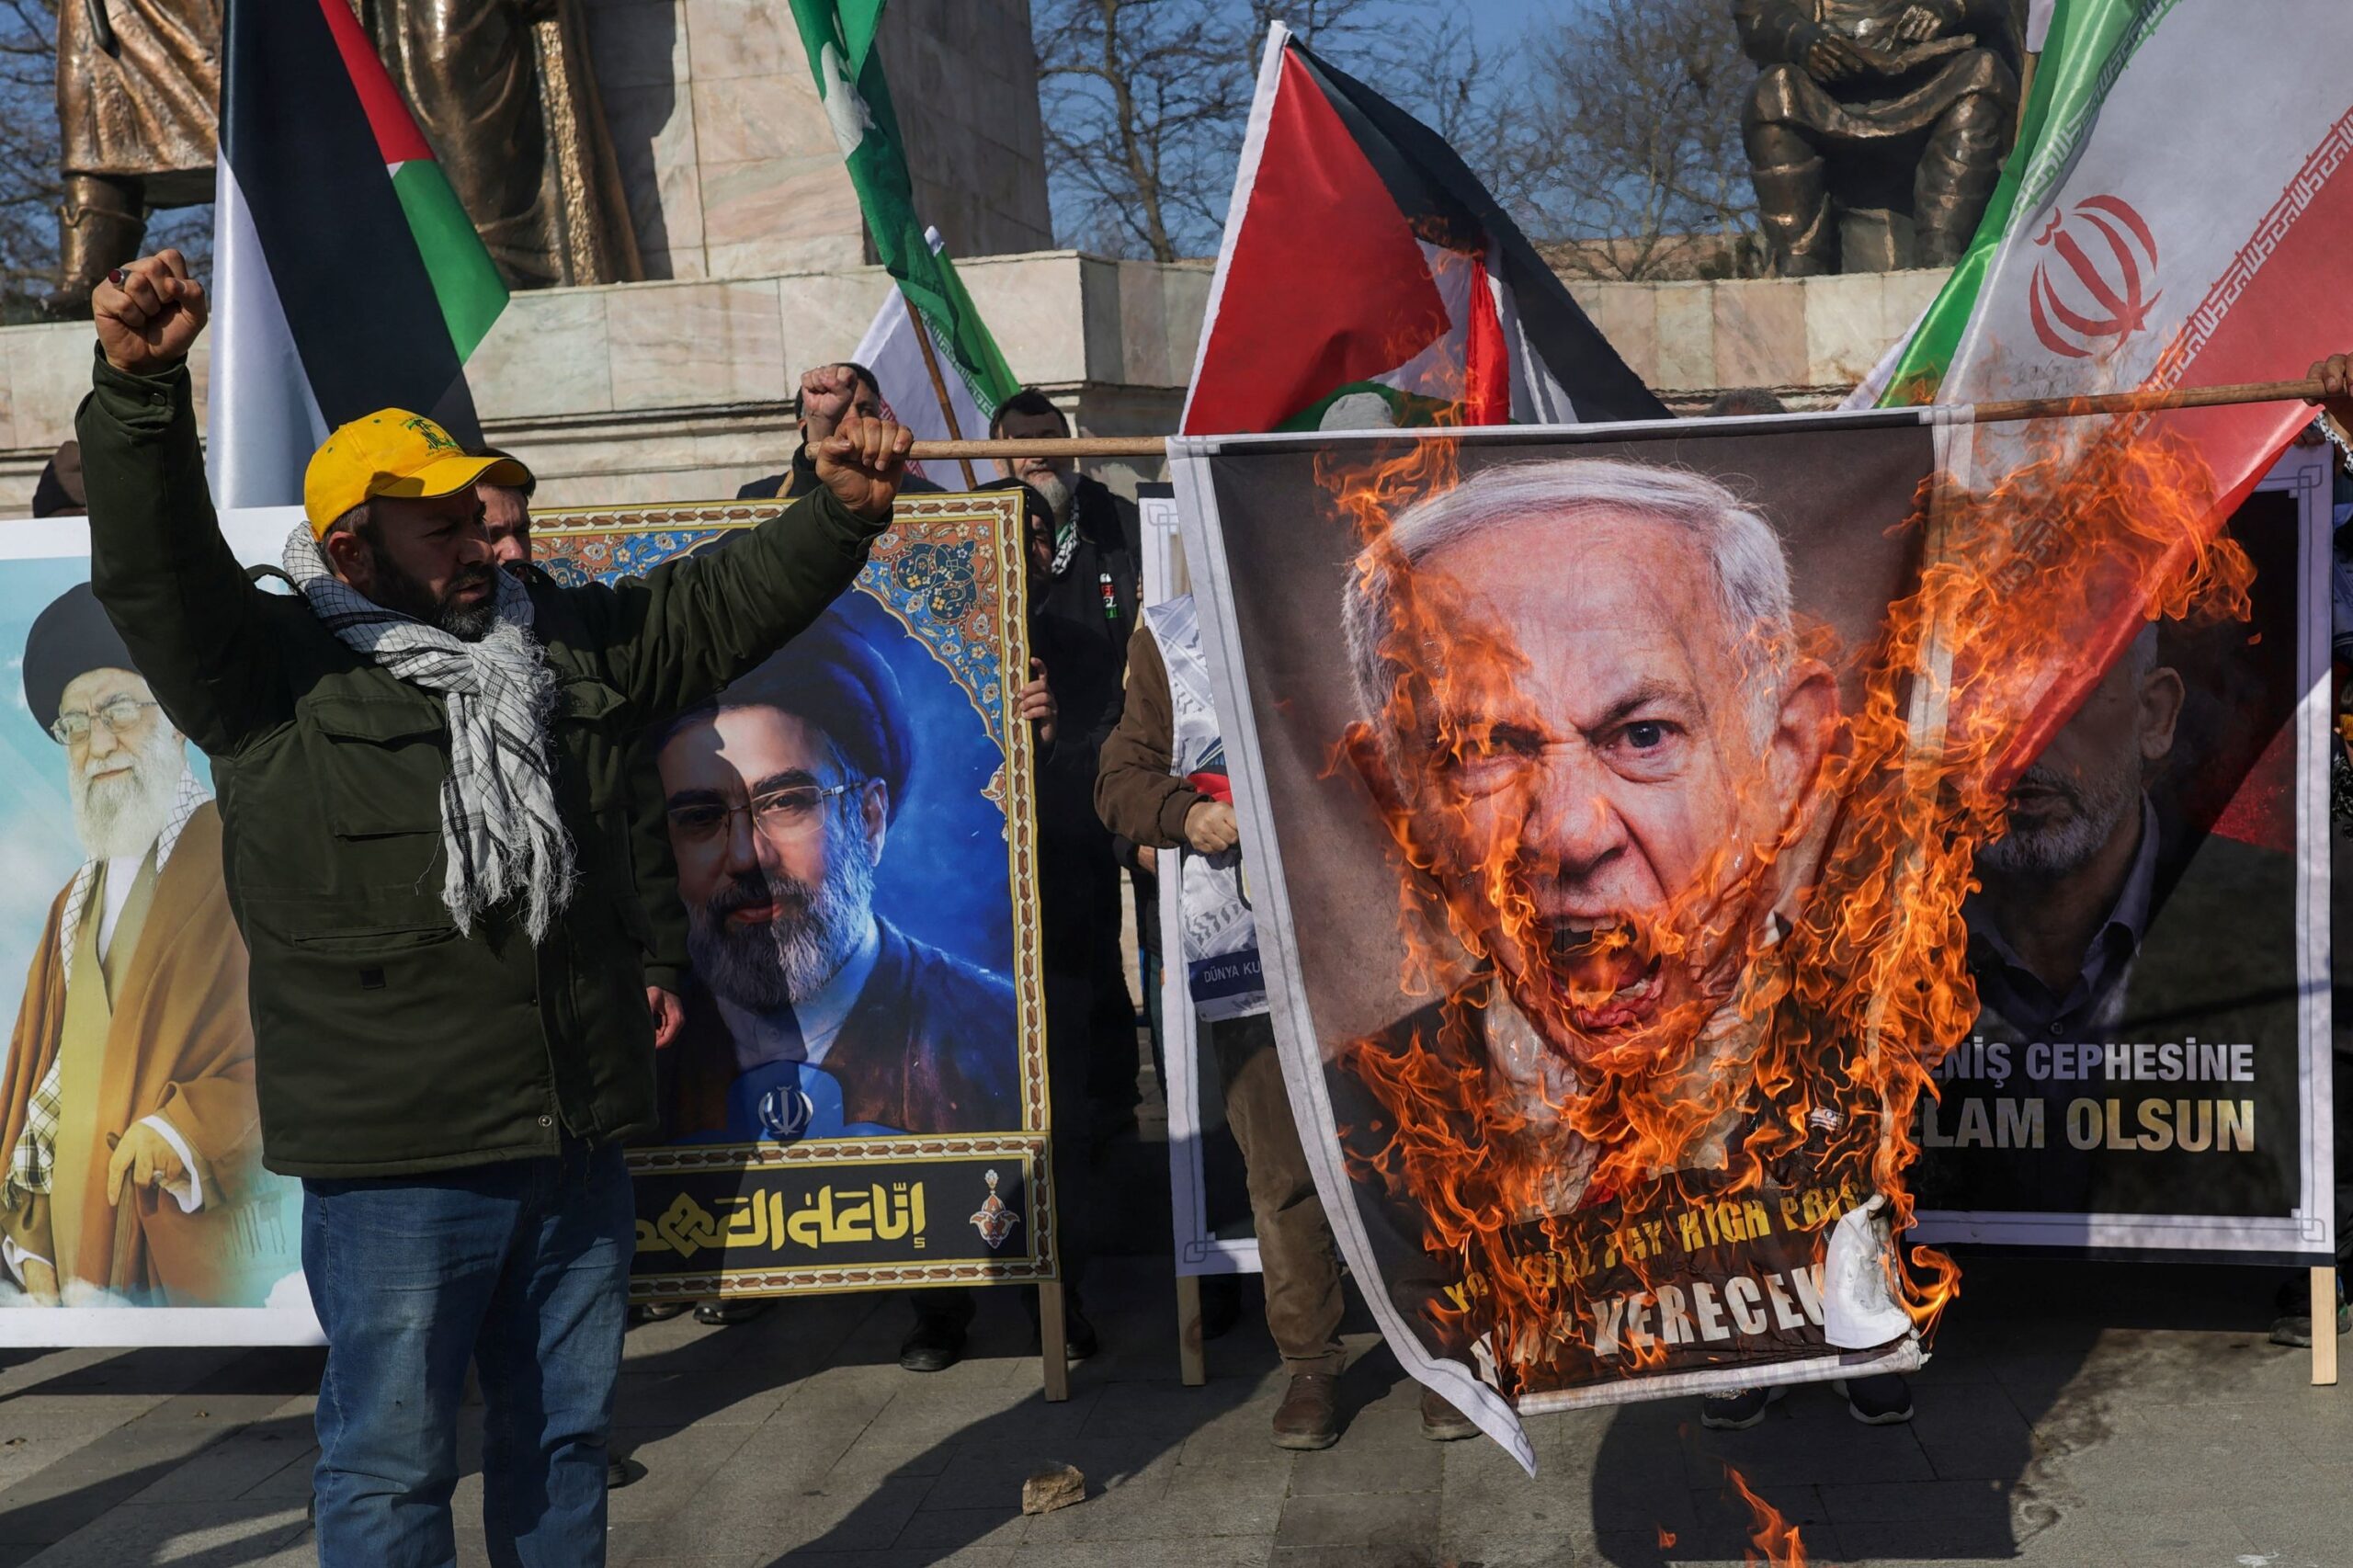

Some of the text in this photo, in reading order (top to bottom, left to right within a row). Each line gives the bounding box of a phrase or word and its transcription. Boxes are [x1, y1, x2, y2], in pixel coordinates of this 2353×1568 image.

[1203, 964, 1240, 983] DÜNYA
[2025, 1037, 2255, 1082] CEPHESİNE
[1909, 1096, 2255, 1153] LAM OLSUN
[1677, 1199, 1772, 1254] HIGH
